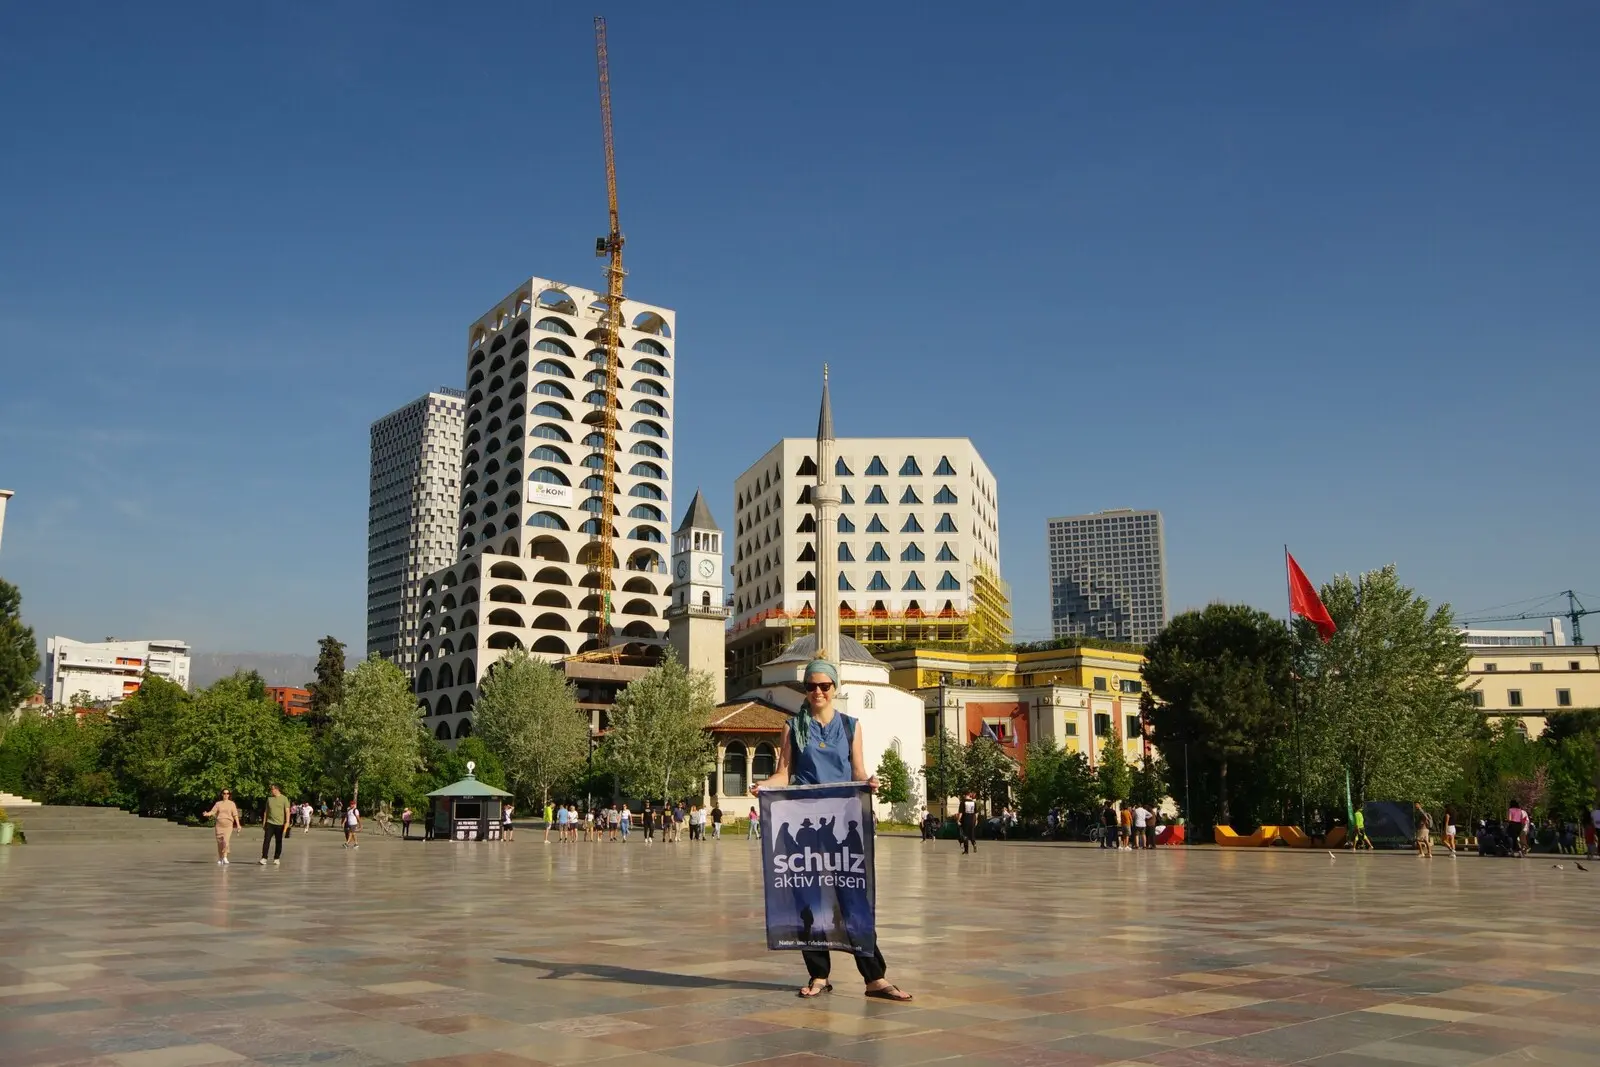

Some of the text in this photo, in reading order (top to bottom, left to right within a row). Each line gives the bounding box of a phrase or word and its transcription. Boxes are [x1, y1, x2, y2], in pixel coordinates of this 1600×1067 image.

[773, 846, 865, 873] schulz
[774, 873, 866, 889] aktiv reisen
